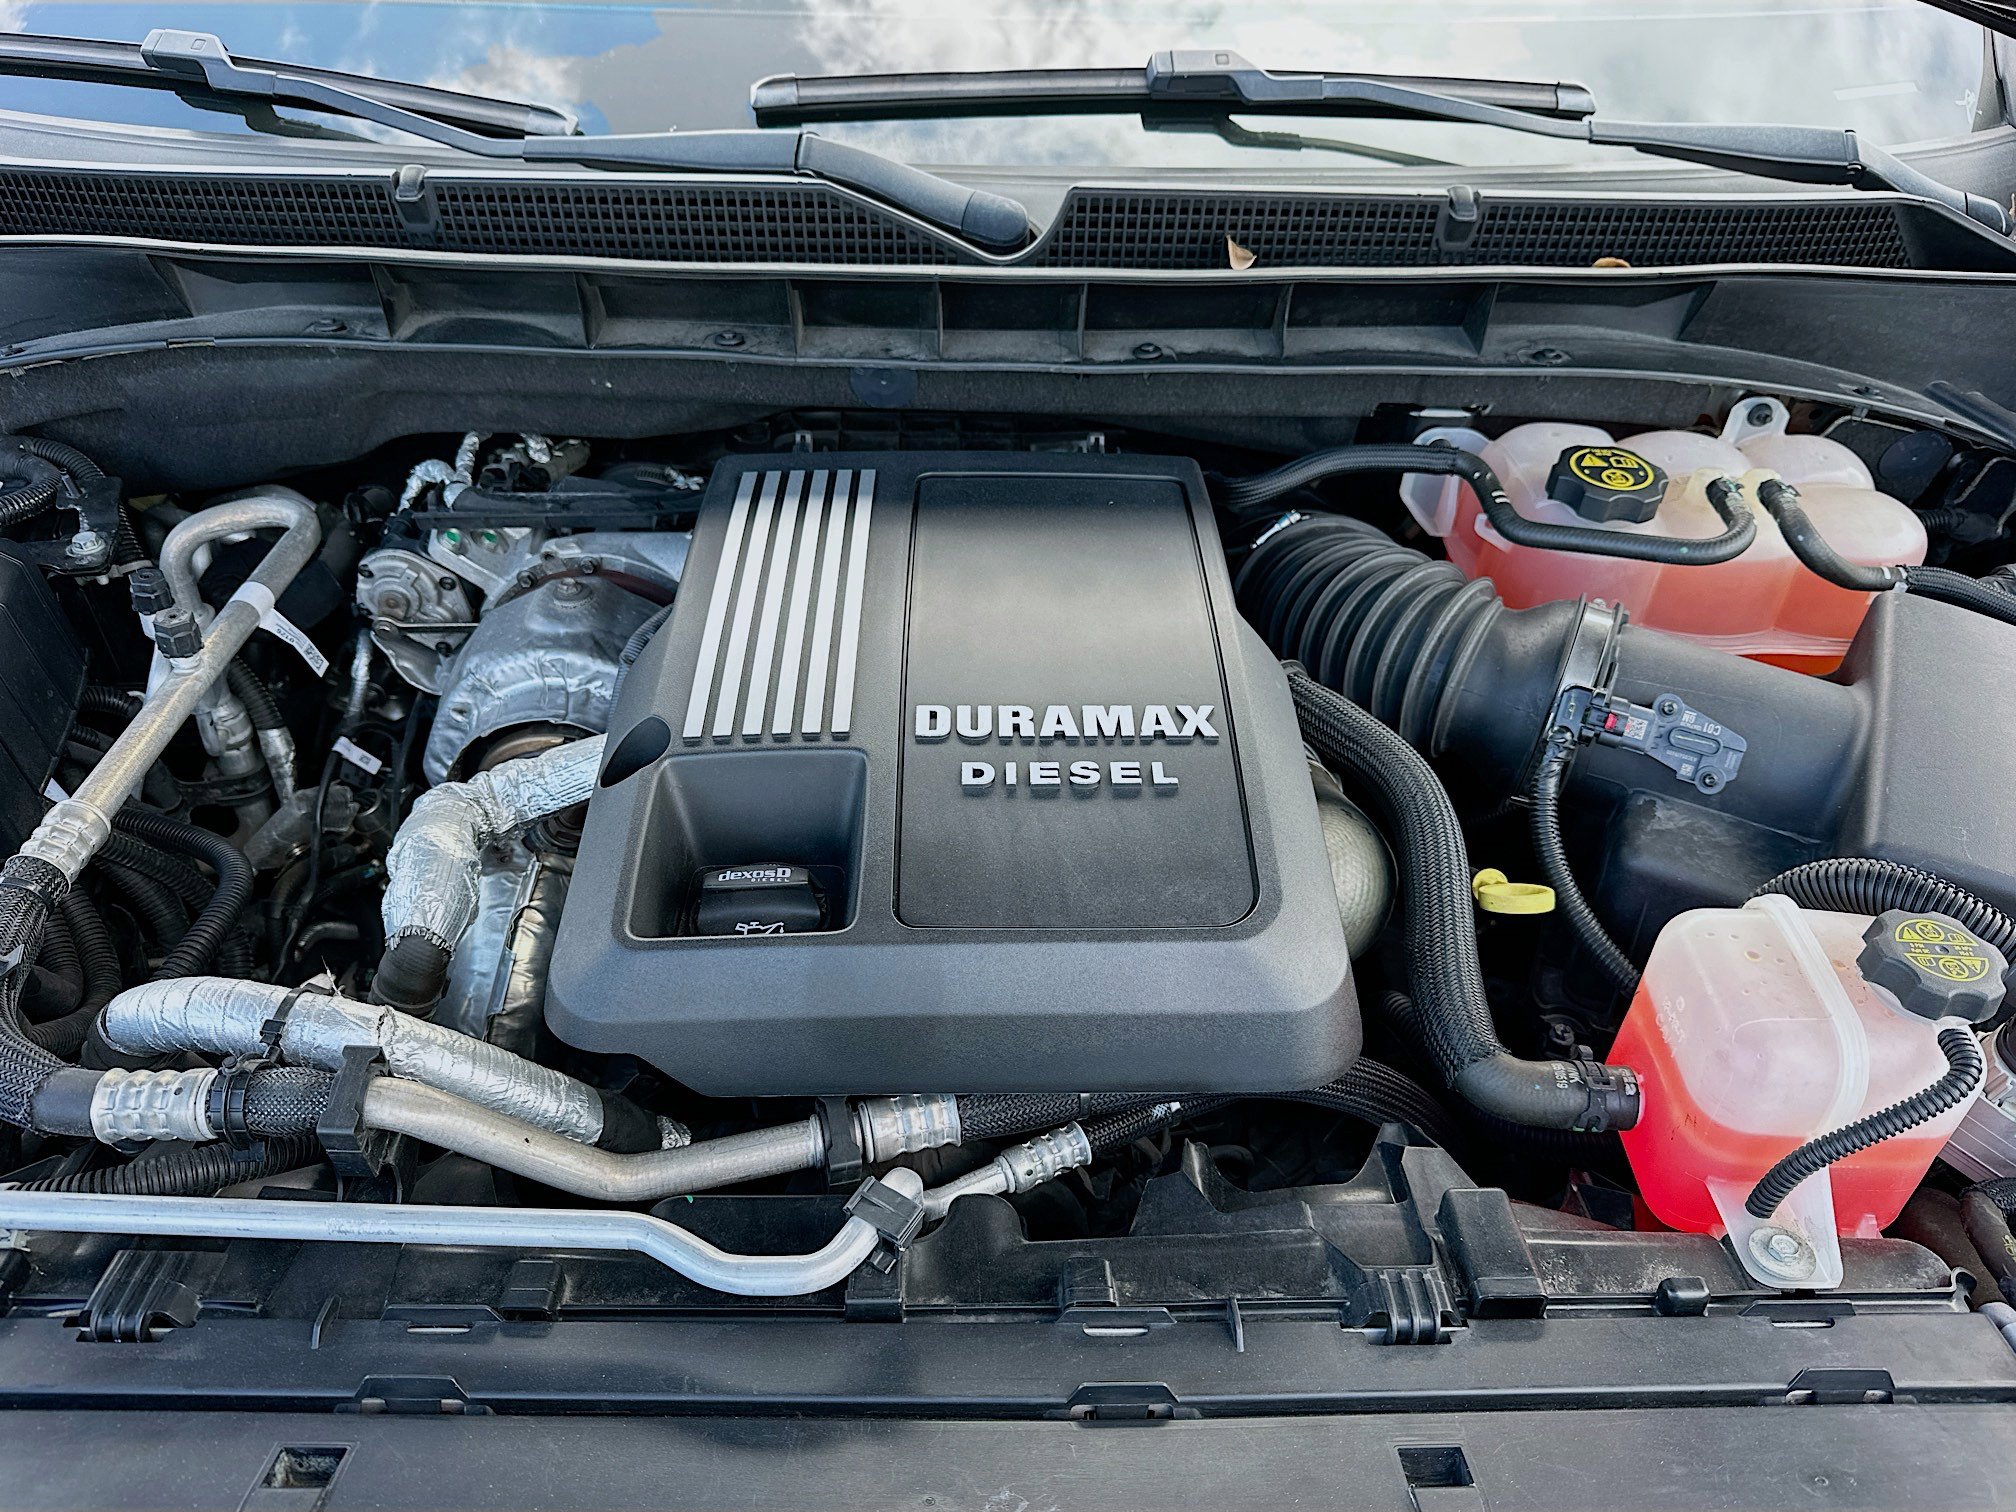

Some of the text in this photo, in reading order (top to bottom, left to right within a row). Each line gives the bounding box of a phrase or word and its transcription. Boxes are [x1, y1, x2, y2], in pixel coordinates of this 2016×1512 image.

[915, 705, 1219, 741] DURAMAX
[1682, 711, 1697, 724] GM
[1703, 722, 1721, 735] C01
[961, 761, 1179, 787] DIESEL
[718, 868, 791, 882] dexosD
